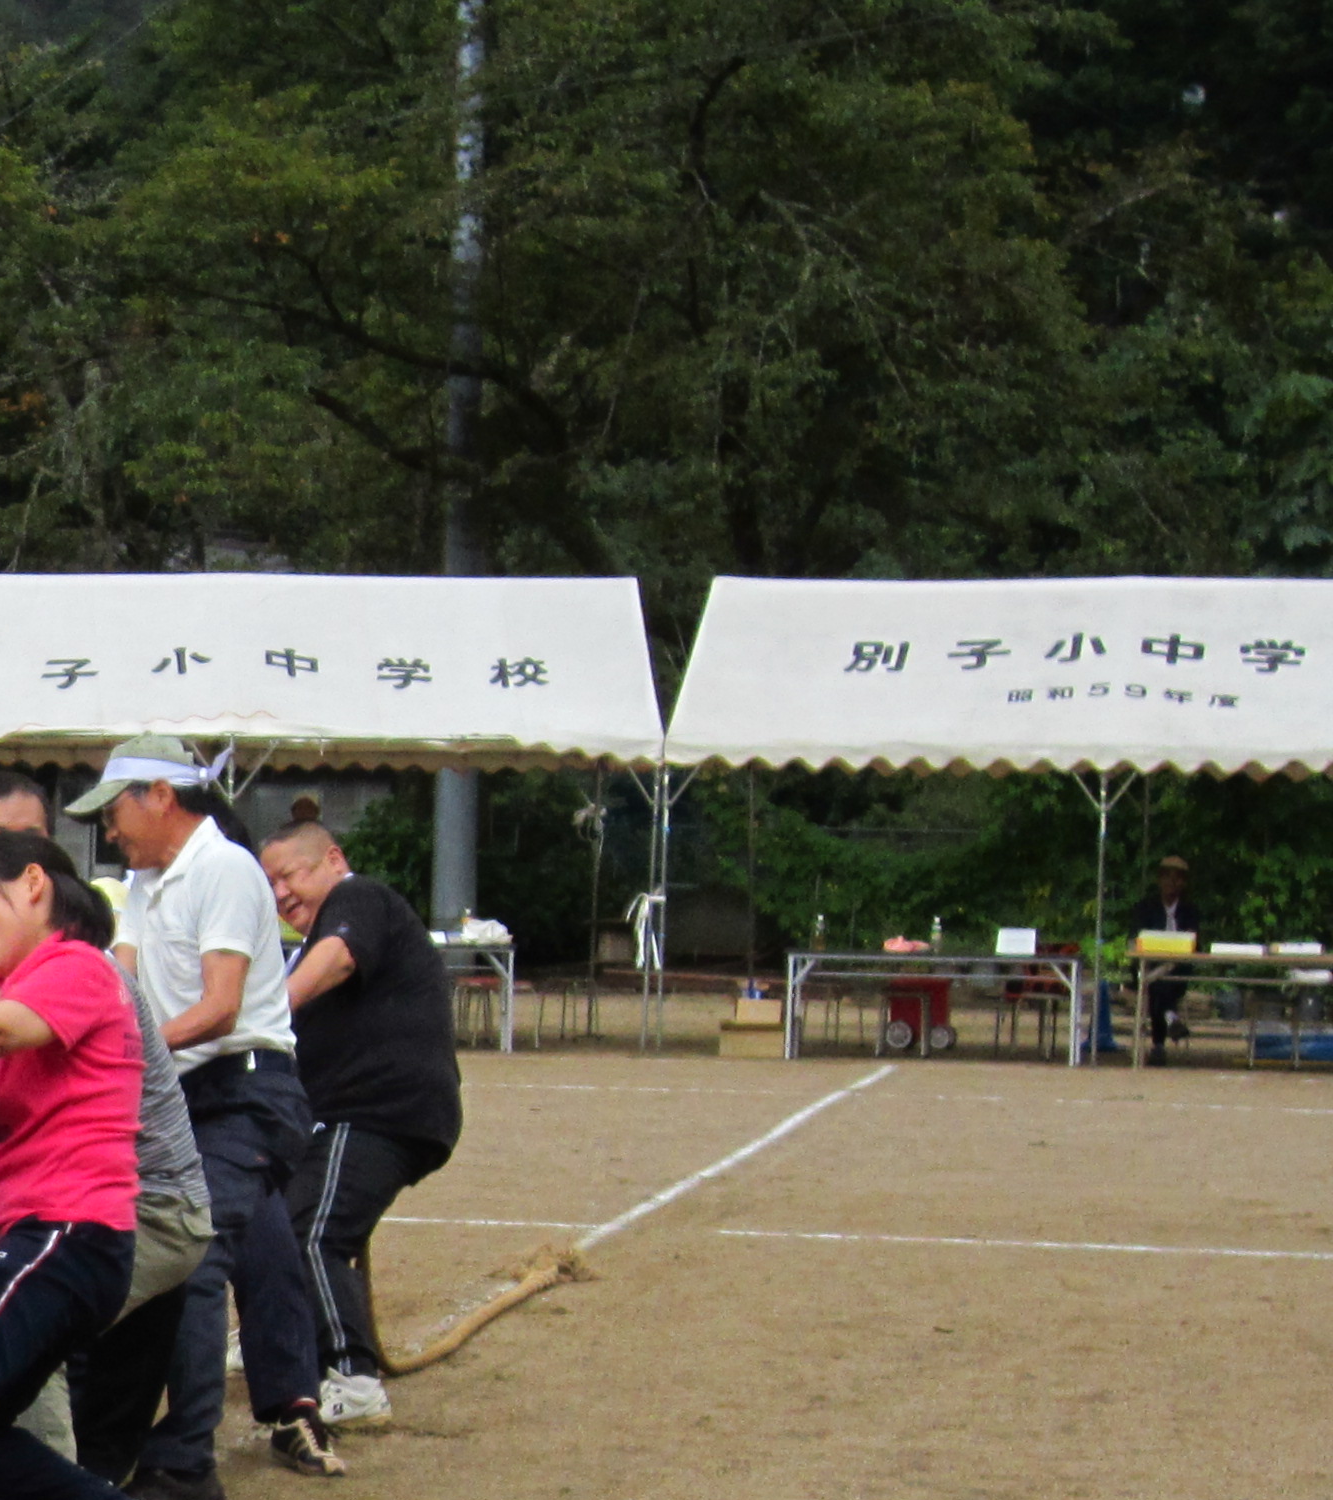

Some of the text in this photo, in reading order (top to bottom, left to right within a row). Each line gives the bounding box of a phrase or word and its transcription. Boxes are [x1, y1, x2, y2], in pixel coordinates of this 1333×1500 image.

[844, 633, 1306, 672] 別子小中学
[1007, 682, 1240, 707] 昭和59年度
